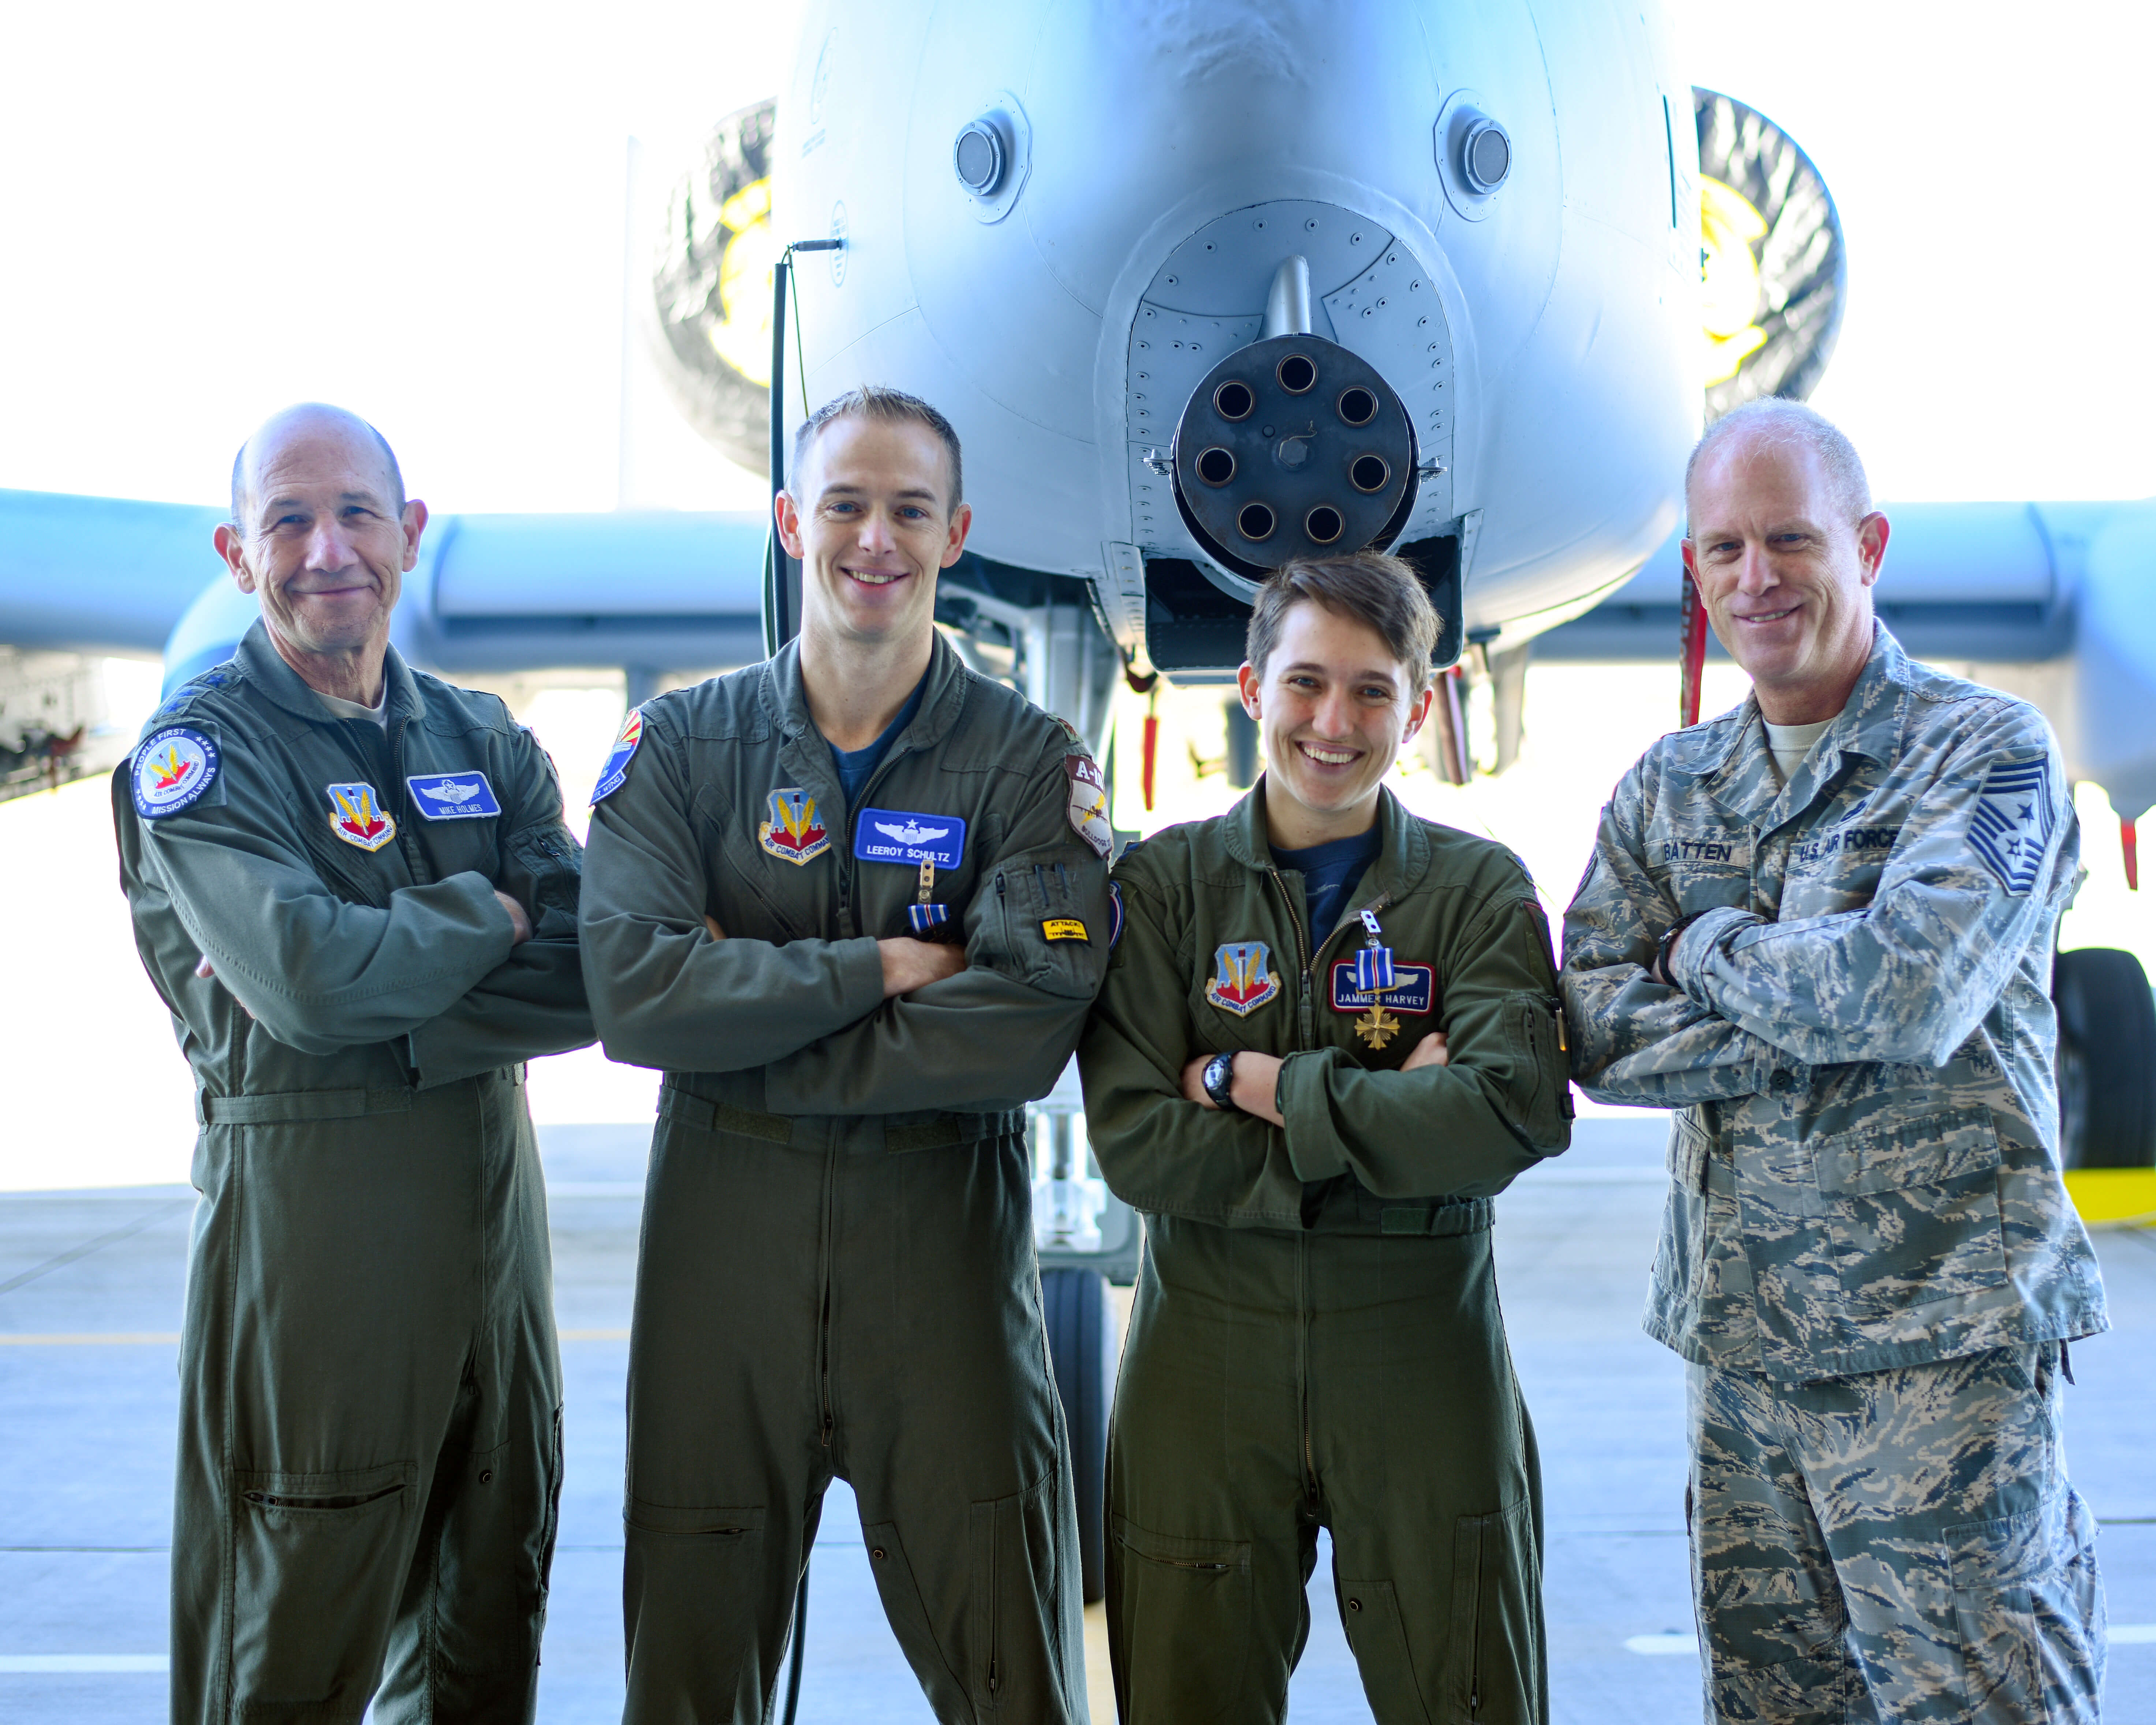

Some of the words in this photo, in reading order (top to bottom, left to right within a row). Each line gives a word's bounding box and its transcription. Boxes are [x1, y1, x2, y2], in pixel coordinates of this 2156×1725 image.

[135, 739, 157, 776] PEOPLE
[158, 729, 186, 741] FIRST
[164, 783, 184, 795] COMBAT
[183, 761, 199, 784] COMMAND
[603, 776, 621, 792] WING
[1075, 761, 1104, 790] A-10
[152, 797, 188, 814] MISSION
[189, 767, 216, 801] ALWAYS
[439, 806, 457, 815] MIKE
[456, 804, 483, 813] HOLMES
[337, 827, 348, 838] AIR
[350, 835, 374, 848] COMBAT
[373, 825, 392, 845] COMMAND
[764, 837, 775, 849] AIR
[776, 845, 803, 860] COMBAT
[866, 845, 903, 856] LEEROY
[907, 848, 950, 862] SCHULTZ
[1664, 842, 1732, 862] BATTEN
[1211, 992, 1221, 1003] AIR
[1221, 999, 1246, 1013] COMBAT
[1247, 986, 1276, 1009] COMMAND
[1385, 994, 1425, 1006] HARVEY
